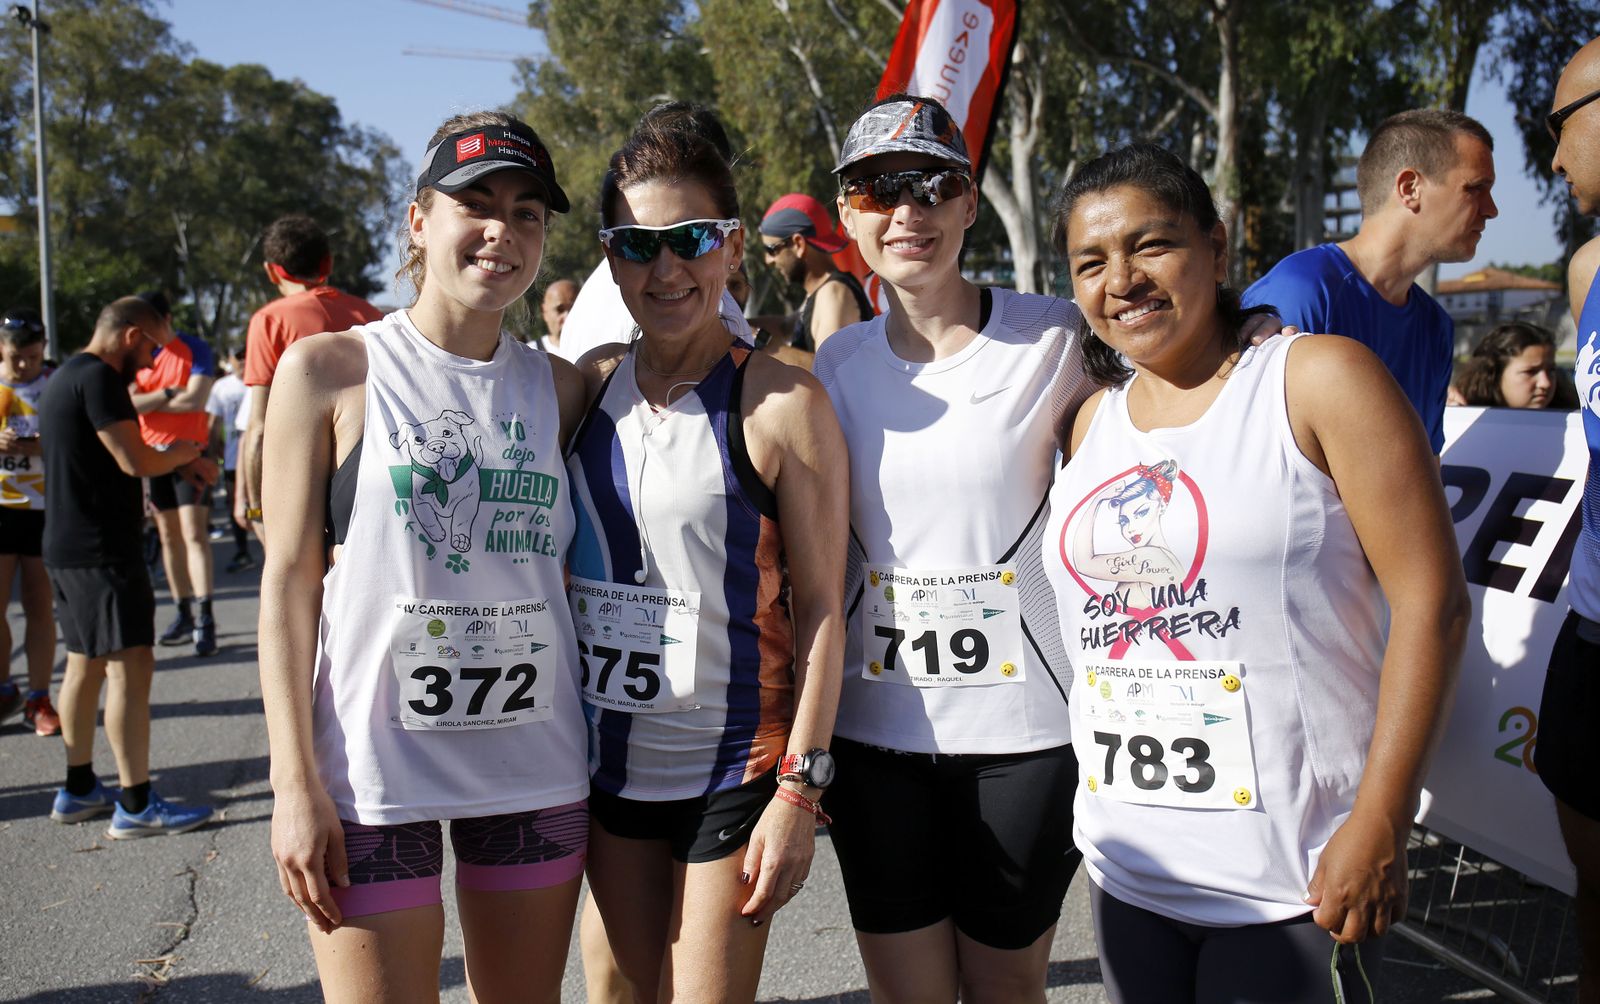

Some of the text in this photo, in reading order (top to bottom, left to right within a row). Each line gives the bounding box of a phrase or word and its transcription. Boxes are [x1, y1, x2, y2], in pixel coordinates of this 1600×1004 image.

[503, 131, 531, 147] Haspa
[498, 147, 537, 167] Hamburg
[500, 421, 526, 442] YO
[0, 455, 31, 472] 64
[502, 443, 535, 469] dejo
[489, 472, 554, 505] HUELLA
[491, 506, 551, 529] por los
[485, 530, 557, 558] ANIMALES
[1106, 555, 1172, 575] Girl Power
[879, 570, 1002, 586] CARRERA DE LA PRENSA
[574, 583, 609, 599] CARRERA
[611, 591, 624, 601] DE
[626, 593, 639, 603] LA
[641, 594, 686, 607] PRENSA
[911, 589, 938, 602] APM
[1083, 578, 1208, 620] SOY UNA
[404, 602, 547, 617] IV CARRERA DE LA PRENSA
[598, 602, 622, 617] APM
[465, 620, 496, 635] APM
[1080, 606, 1241, 651] GUERRERA
[874, 625, 989, 675] 719
[1095, 665, 1136, 678] CARRERA
[1138, 668, 1153, 679] DE
[1156, 668, 1172, 679] LA
[1175, 668, 1226, 680] PRENSA
[407, 662, 538, 717] 372
[1126, 682, 1154, 698] APM
[617, 699, 637, 708] MARIA
[462, 719, 496, 727] SANCHEZ,
[497, 716, 517, 725] MIRIAM
[1093, 730, 1216, 794] 783
